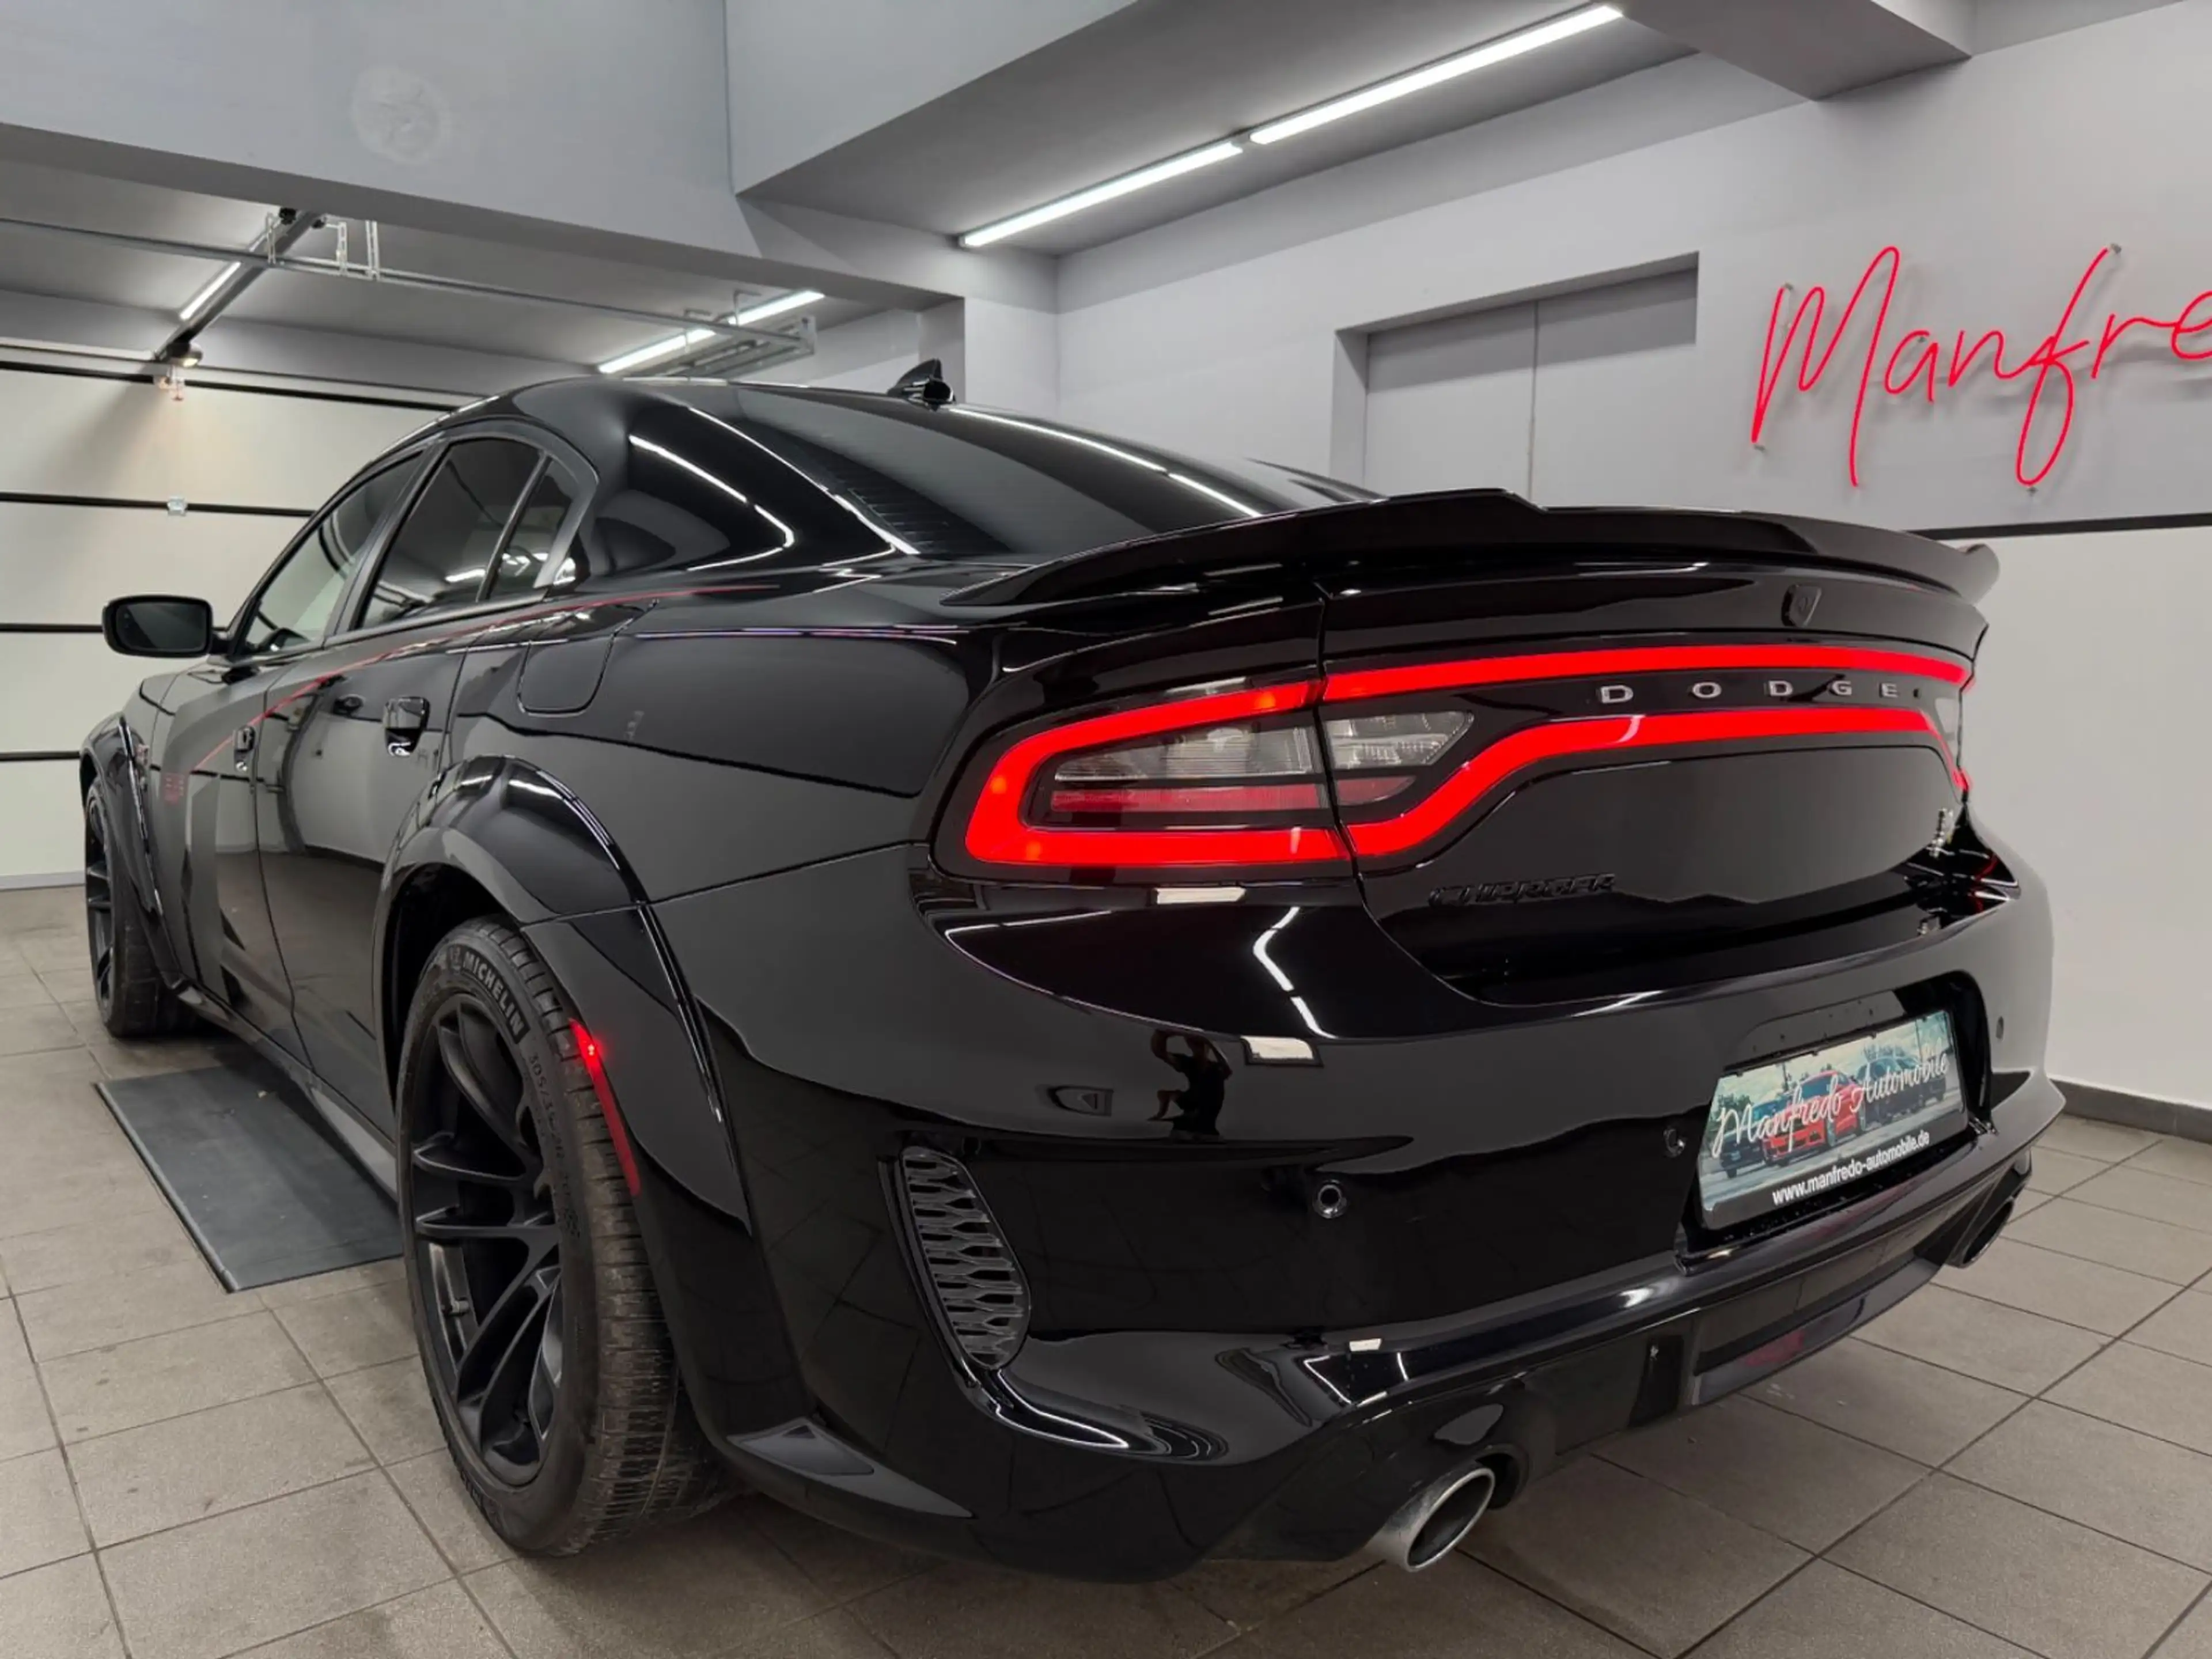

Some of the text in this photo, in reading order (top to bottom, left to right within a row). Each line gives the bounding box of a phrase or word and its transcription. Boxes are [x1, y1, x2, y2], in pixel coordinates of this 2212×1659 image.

[1600, 680, 1898, 704] DODGE
[463, 950, 524, 1035] MICHELIN
[1711, 1038, 1949, 1158] Manfredo Automobile
[1771, 1129, 1930, 1206] www.manfredo-automobile.de
